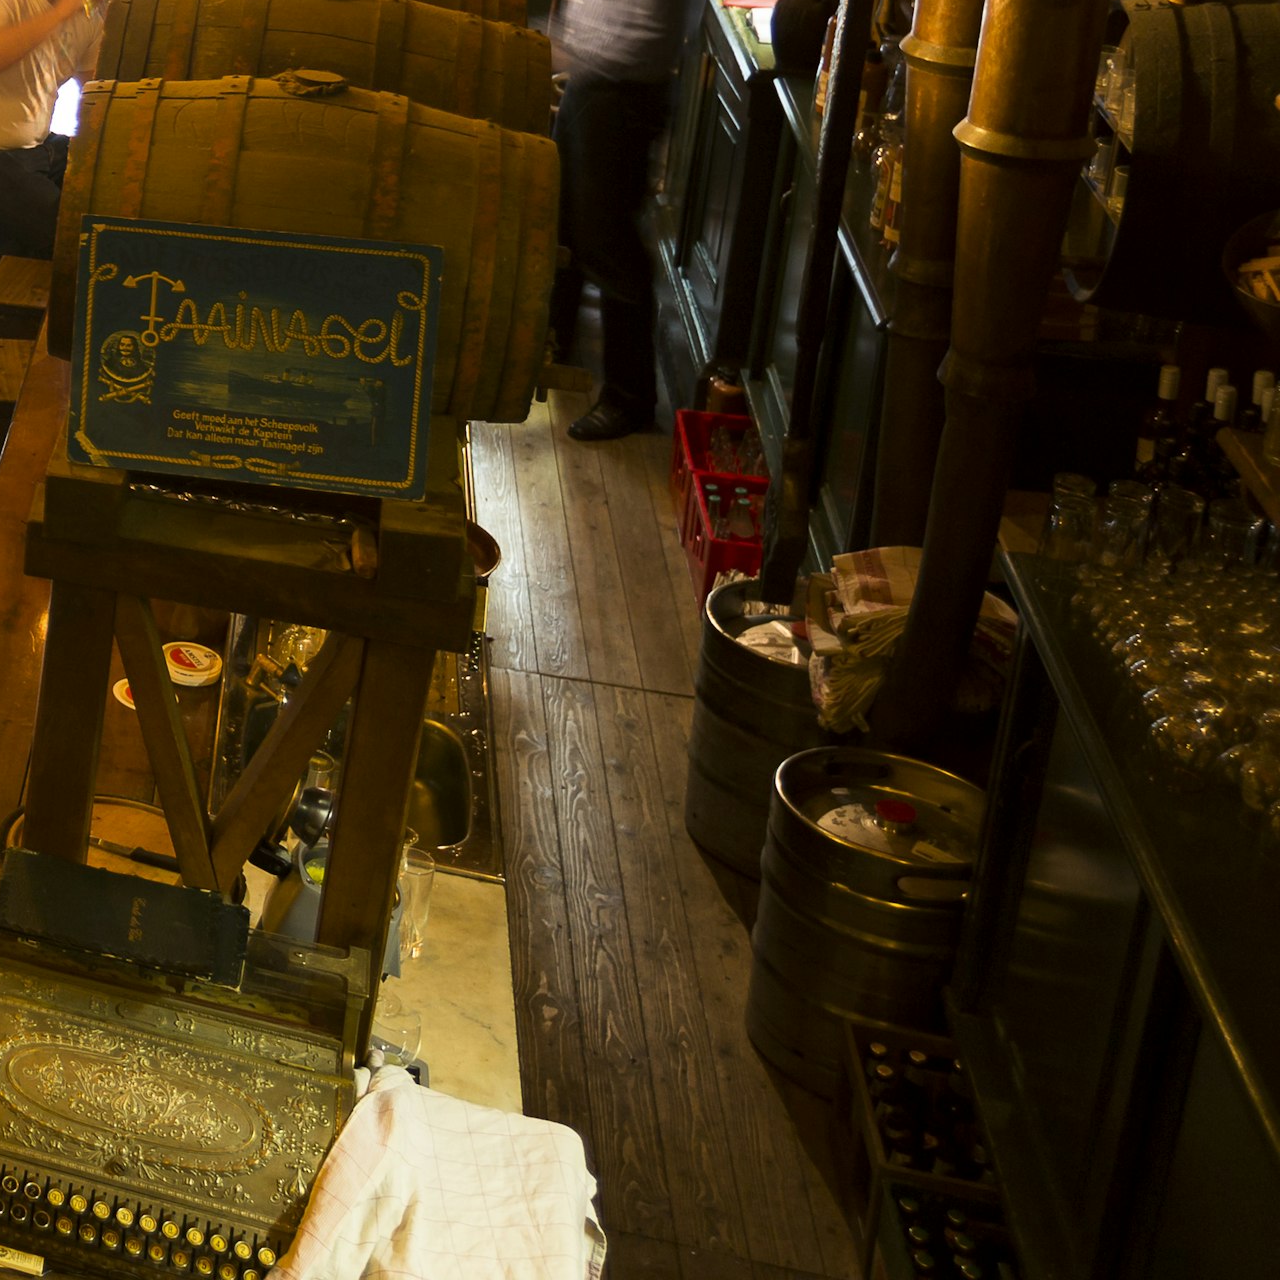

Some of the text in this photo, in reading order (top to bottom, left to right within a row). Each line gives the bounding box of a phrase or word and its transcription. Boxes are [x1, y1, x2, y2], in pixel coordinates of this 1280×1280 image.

[172, 409, 319, 434] Geeft moed aan het Scheepsvolk
[194, 420, 293, 441] Verkwikt de Kapitein
[167, 426, 324, 456] Dat kan alleen maar Taainagel zijn
